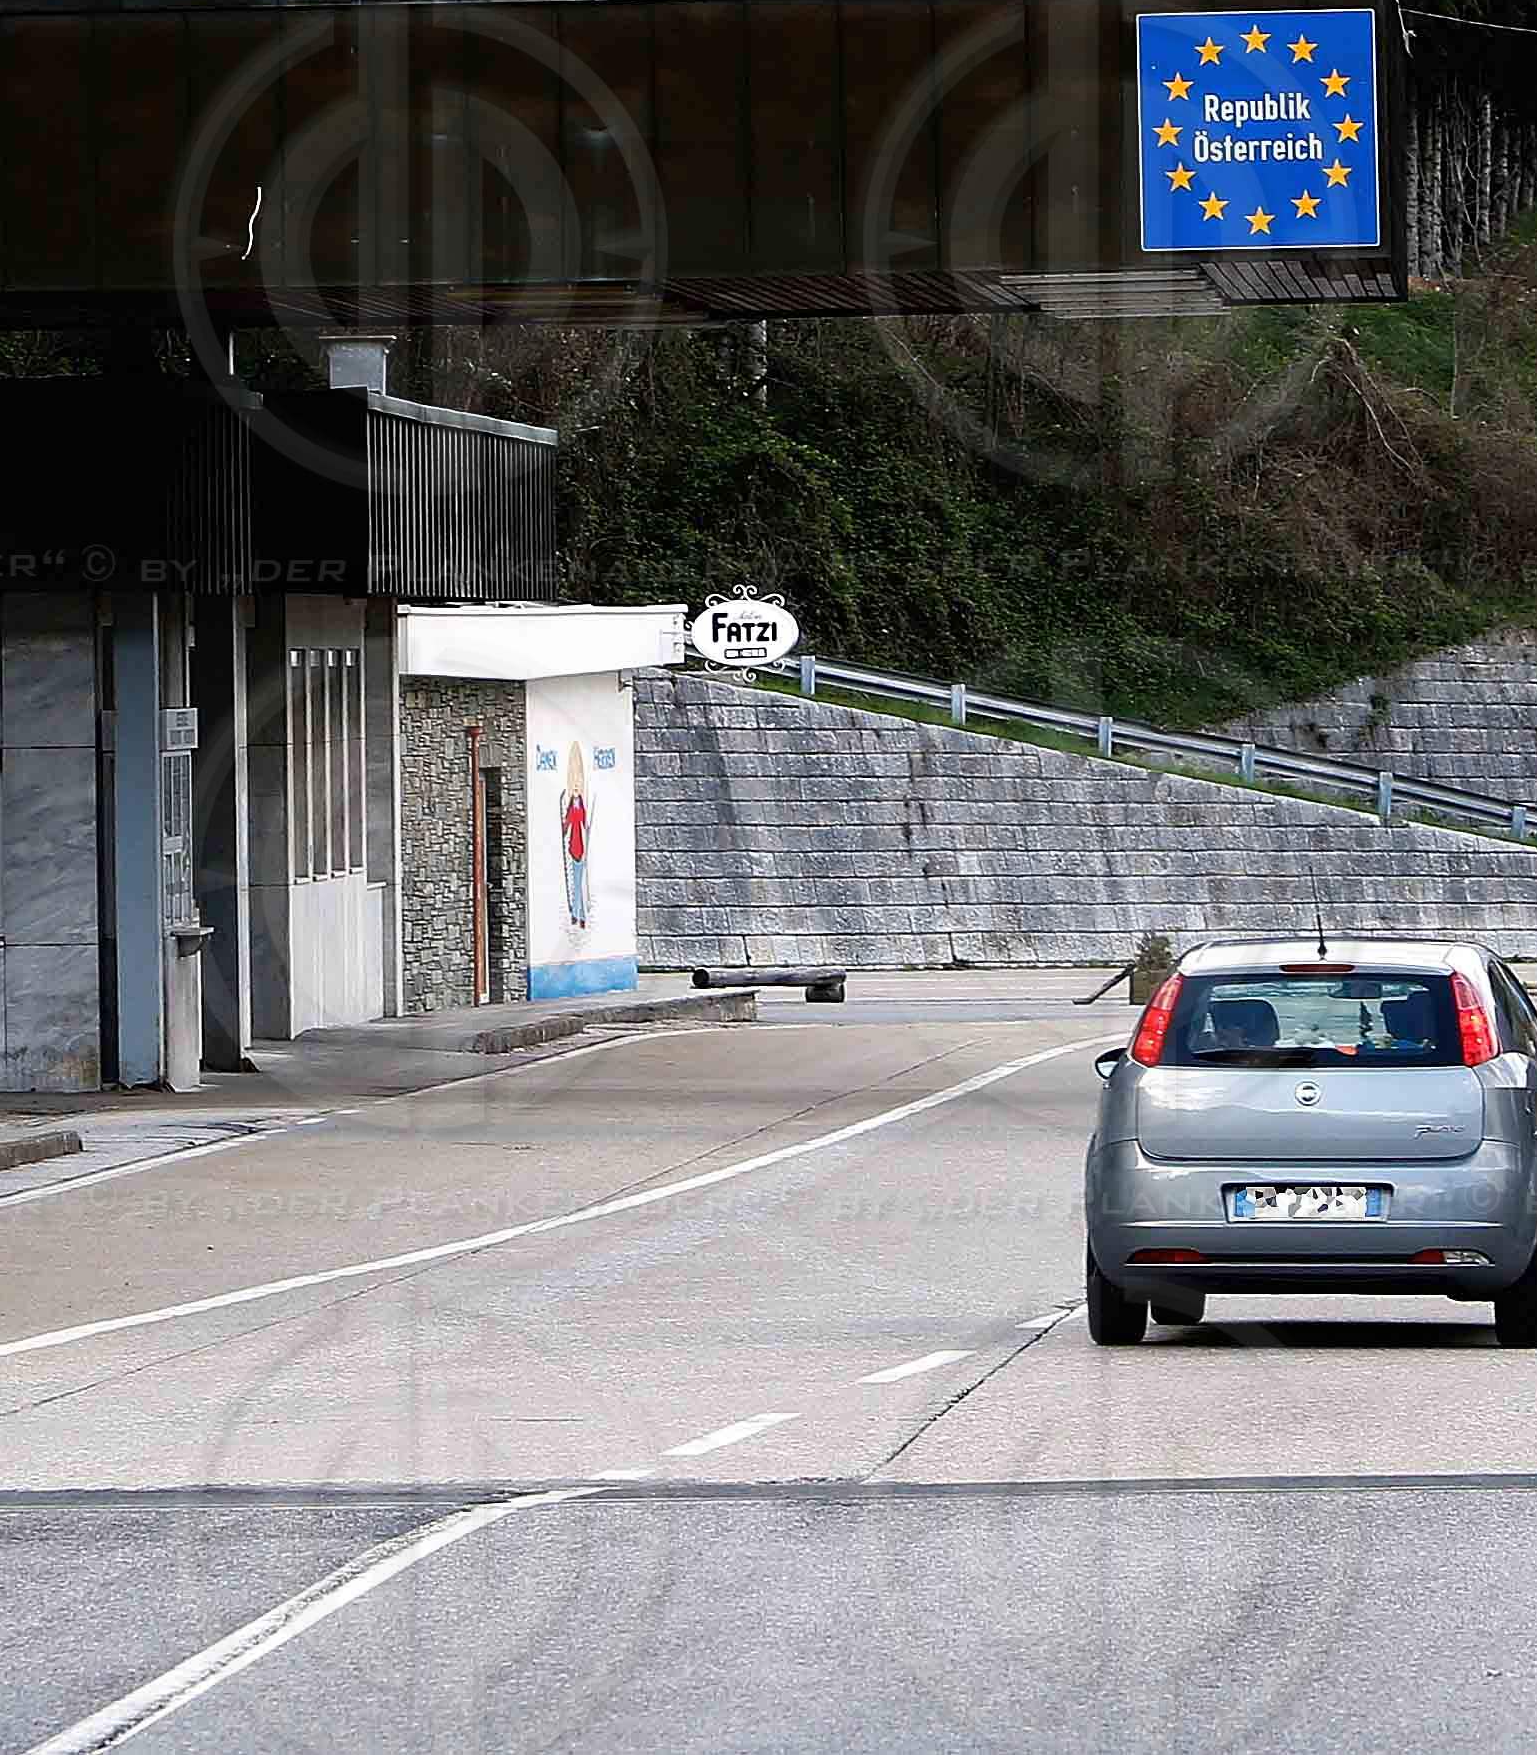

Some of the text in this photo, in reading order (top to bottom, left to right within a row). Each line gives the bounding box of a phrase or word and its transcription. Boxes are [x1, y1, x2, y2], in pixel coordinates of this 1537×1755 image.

[1204, 93, 1311, 127] Republik
[1194, 131, 1323, 163] Österreich
[711, 612, 778, 643] FATZI
